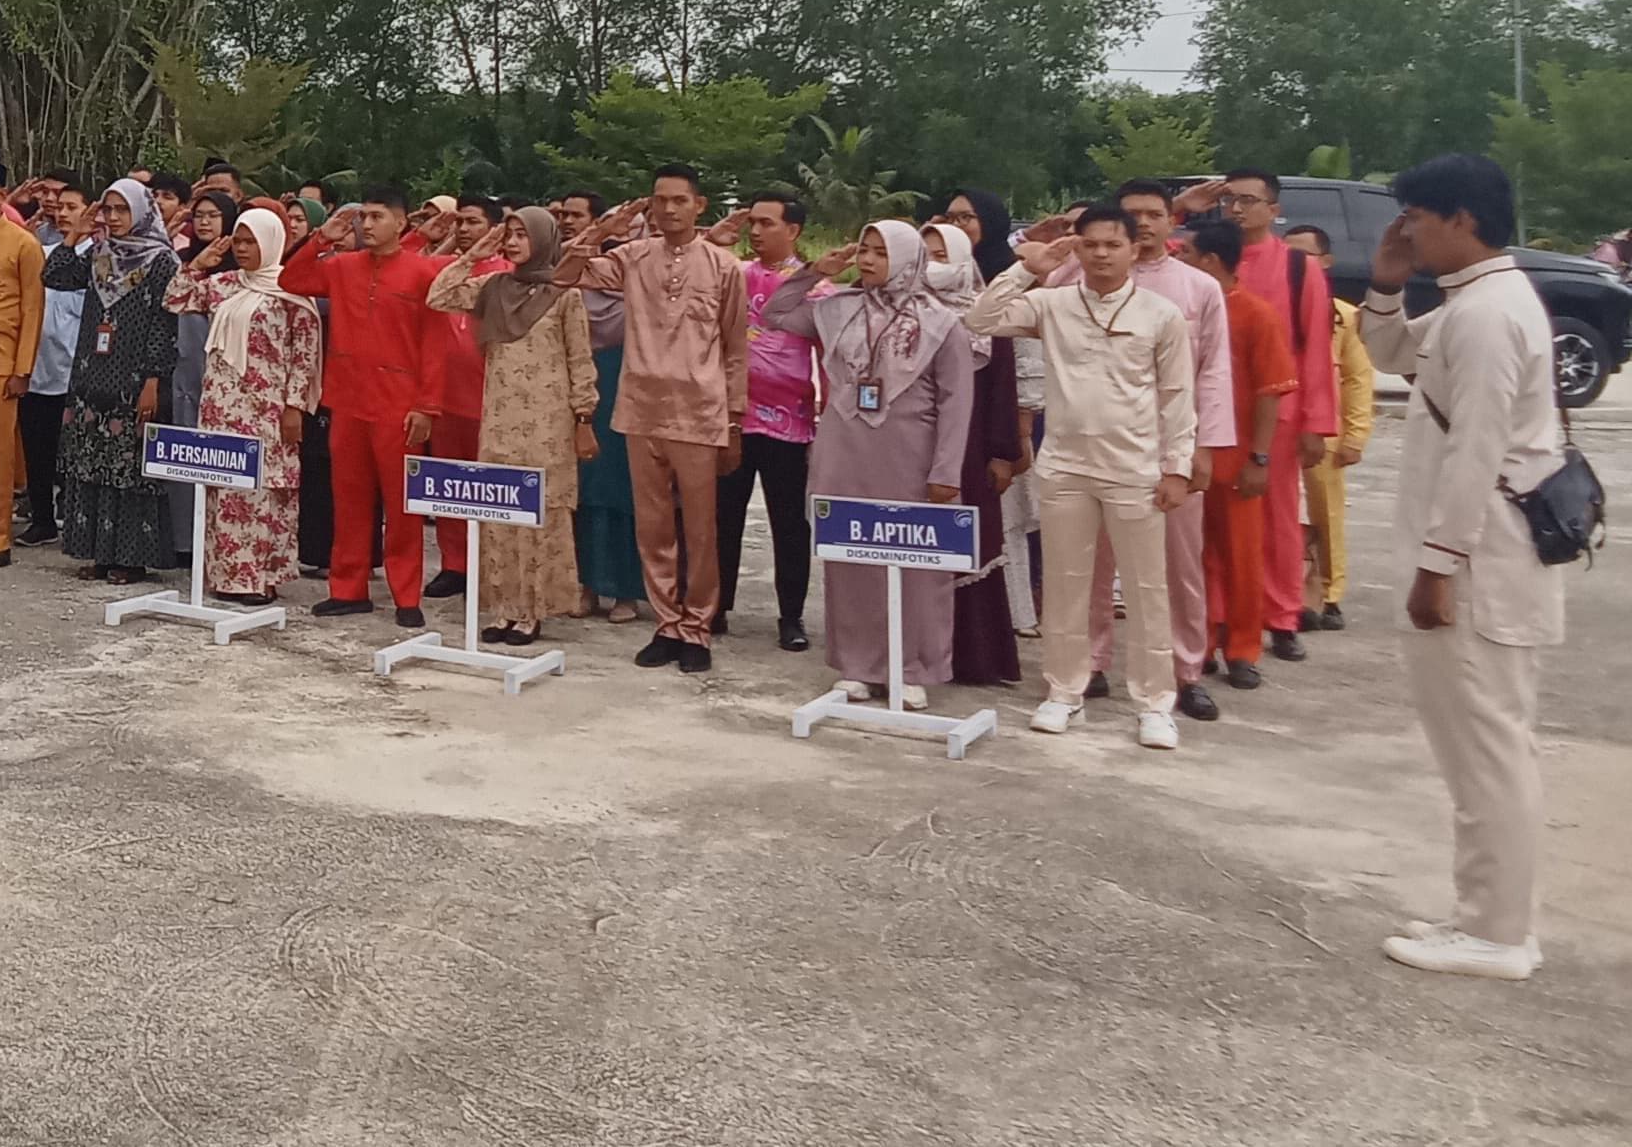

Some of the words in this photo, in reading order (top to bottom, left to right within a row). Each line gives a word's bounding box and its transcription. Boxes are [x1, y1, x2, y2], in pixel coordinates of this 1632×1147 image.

[156, 441, 169, 460] B.
[170, 443, 247, 471] PERSANDIAN
[166, 467, 233, 484] DISKOMINFOTIKS
[424, 476, 440, 497] B.
[443, 479, 521, 506] STATISTIK
[432, 504, 511, 520] DISKOMINFOTIKS
[849, 520, 868, 541] B.
[872, 522, 939, 547] APTIKA
[846, 549, 942, 565] DISKOMINFOTIKS
